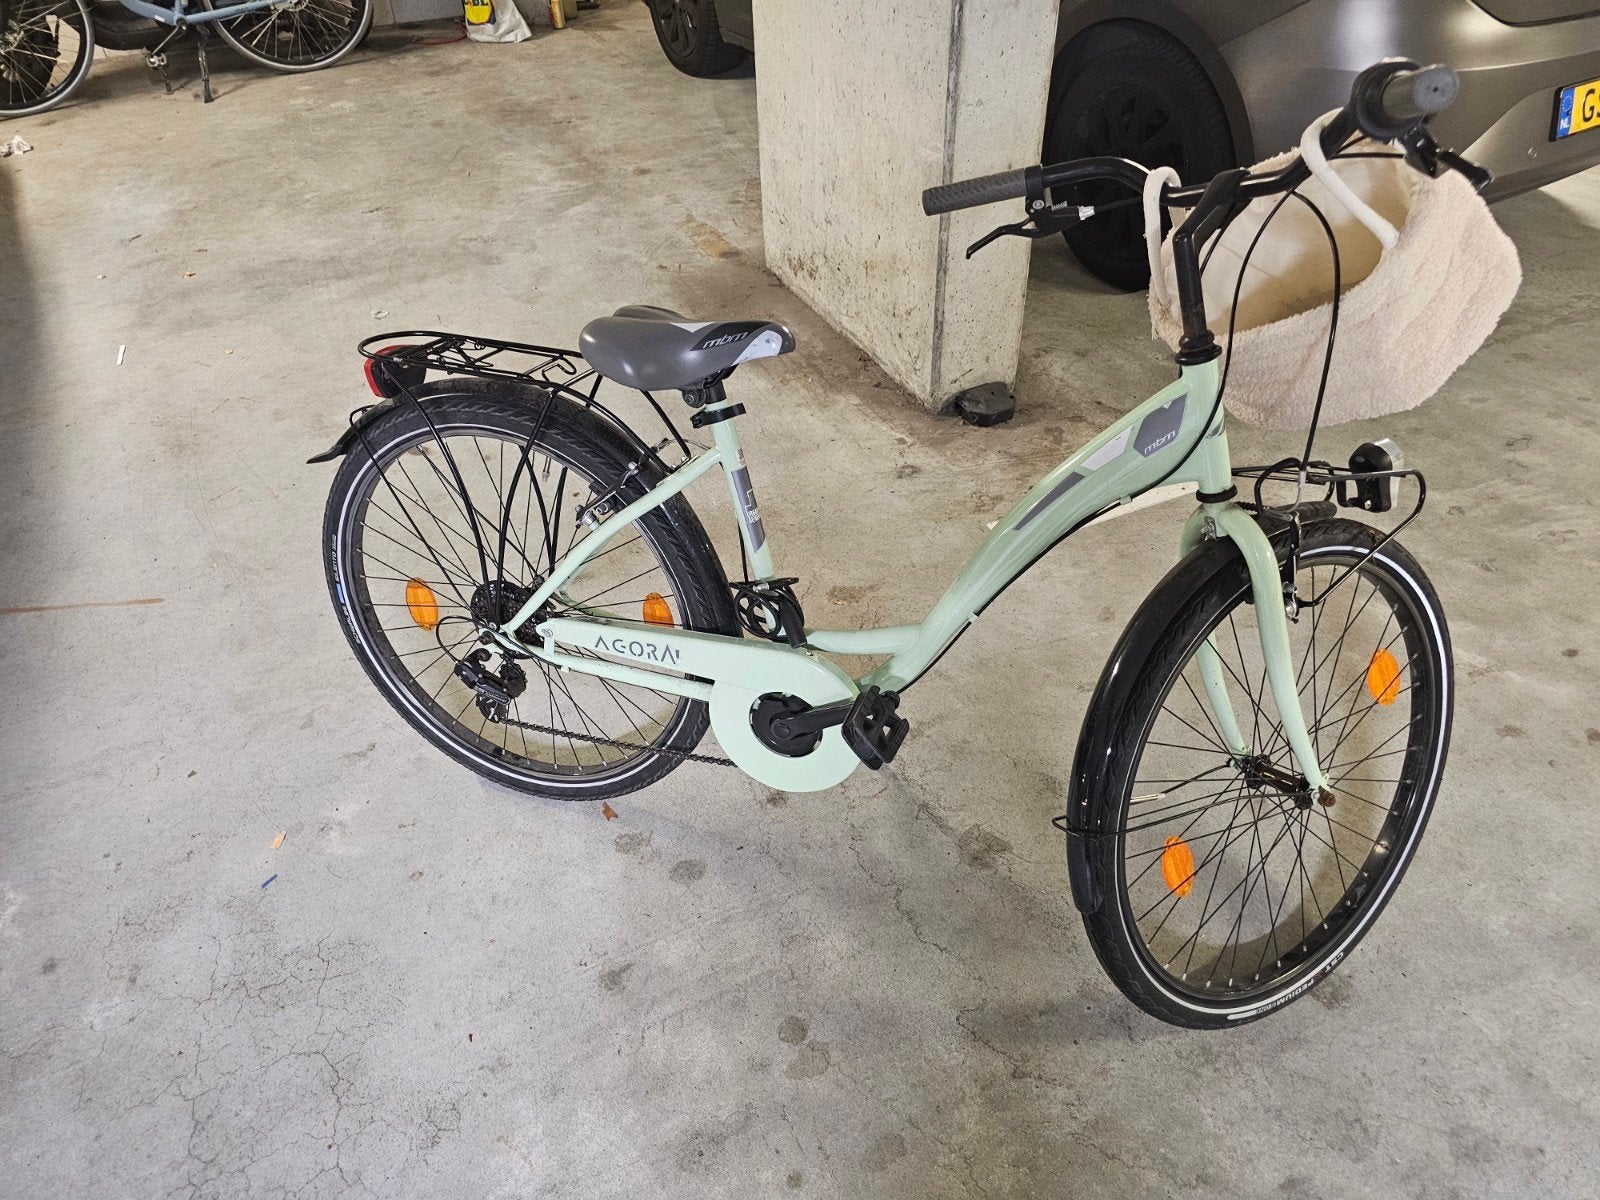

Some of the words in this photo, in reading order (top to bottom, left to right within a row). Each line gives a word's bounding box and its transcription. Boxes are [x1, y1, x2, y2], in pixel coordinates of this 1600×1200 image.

[1560, 116, 1570, 130] NL
[703, 331, 748, 349] mbm
[1144, 430, 1176, 454] mbm
[595, 635, 676, 665] AGORA
[1323, 951, 1344, 973] CST
[1276, 978, 1315, 1006] PEDIUM
